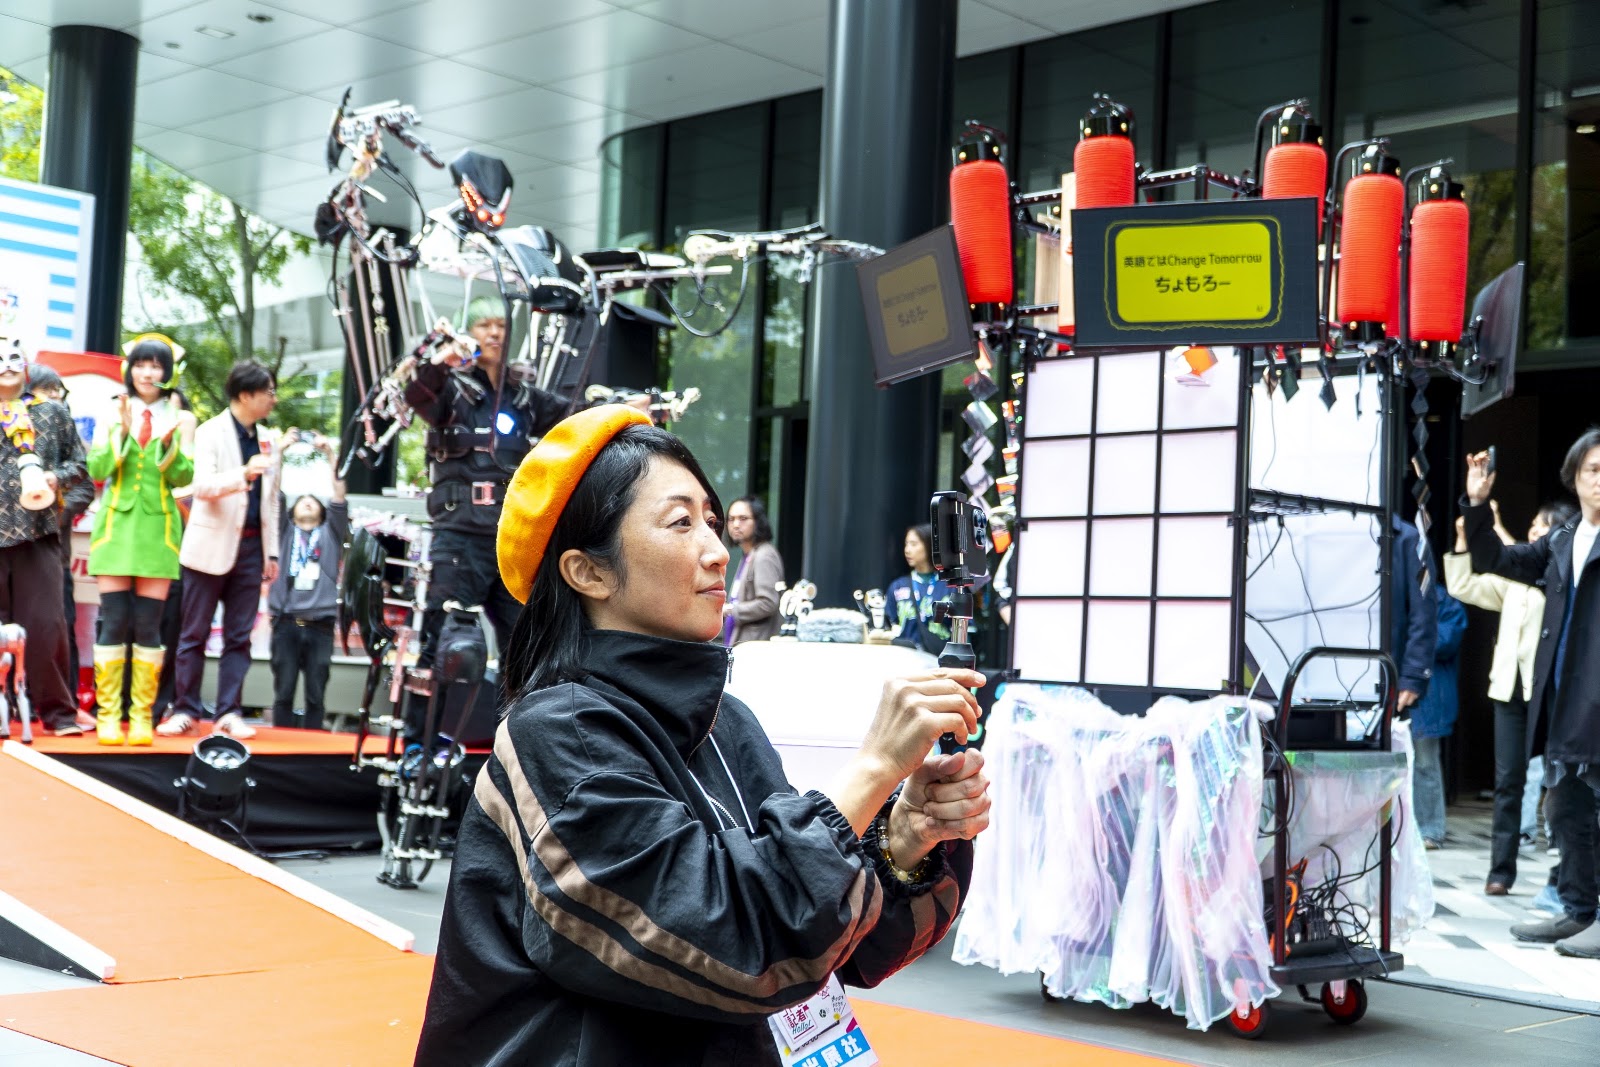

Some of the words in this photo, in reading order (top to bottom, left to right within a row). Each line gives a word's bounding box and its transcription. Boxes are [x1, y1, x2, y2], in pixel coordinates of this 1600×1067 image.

[1209, 253, 1263, 265] Tomorrow
[1155, 274, 1231, 294] ちょもろー
[792, 1019, 812, 1035] Hello!
